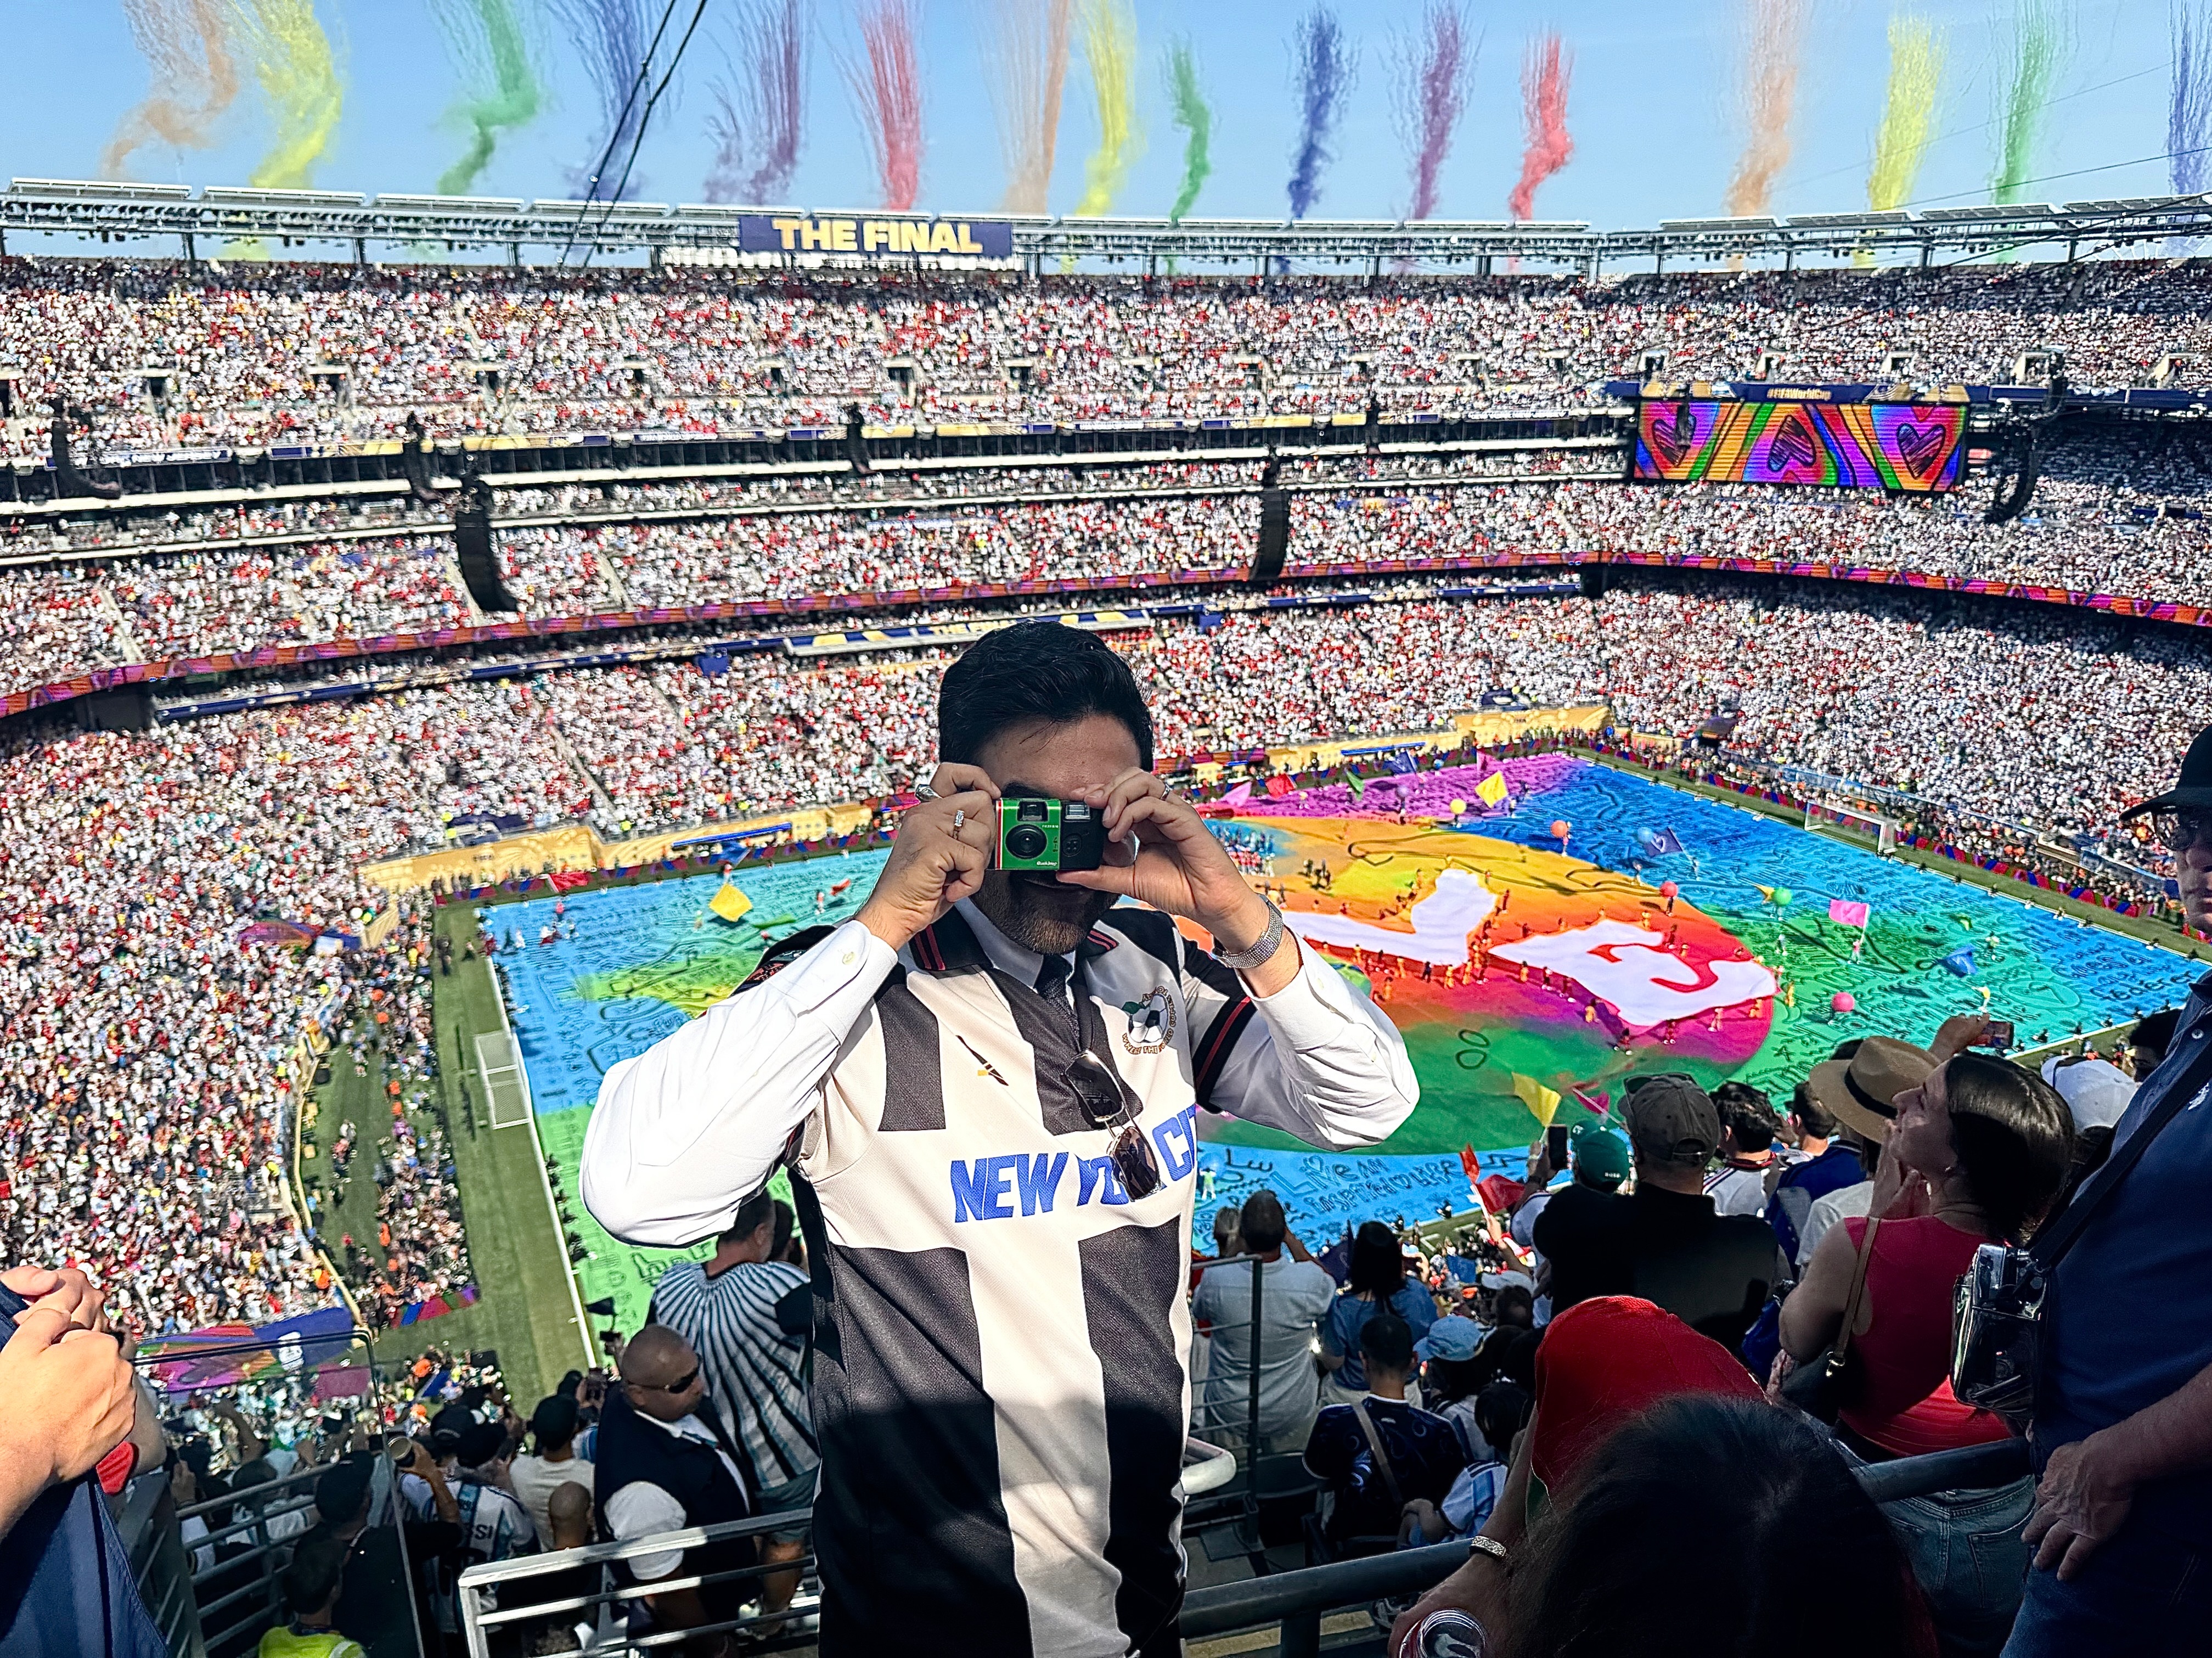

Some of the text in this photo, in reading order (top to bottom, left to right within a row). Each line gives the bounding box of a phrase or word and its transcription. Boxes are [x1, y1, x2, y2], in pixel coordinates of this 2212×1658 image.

[772, 218, 983, 254] THE FINAL
[950, 1152, 1070, 1223] NEW
